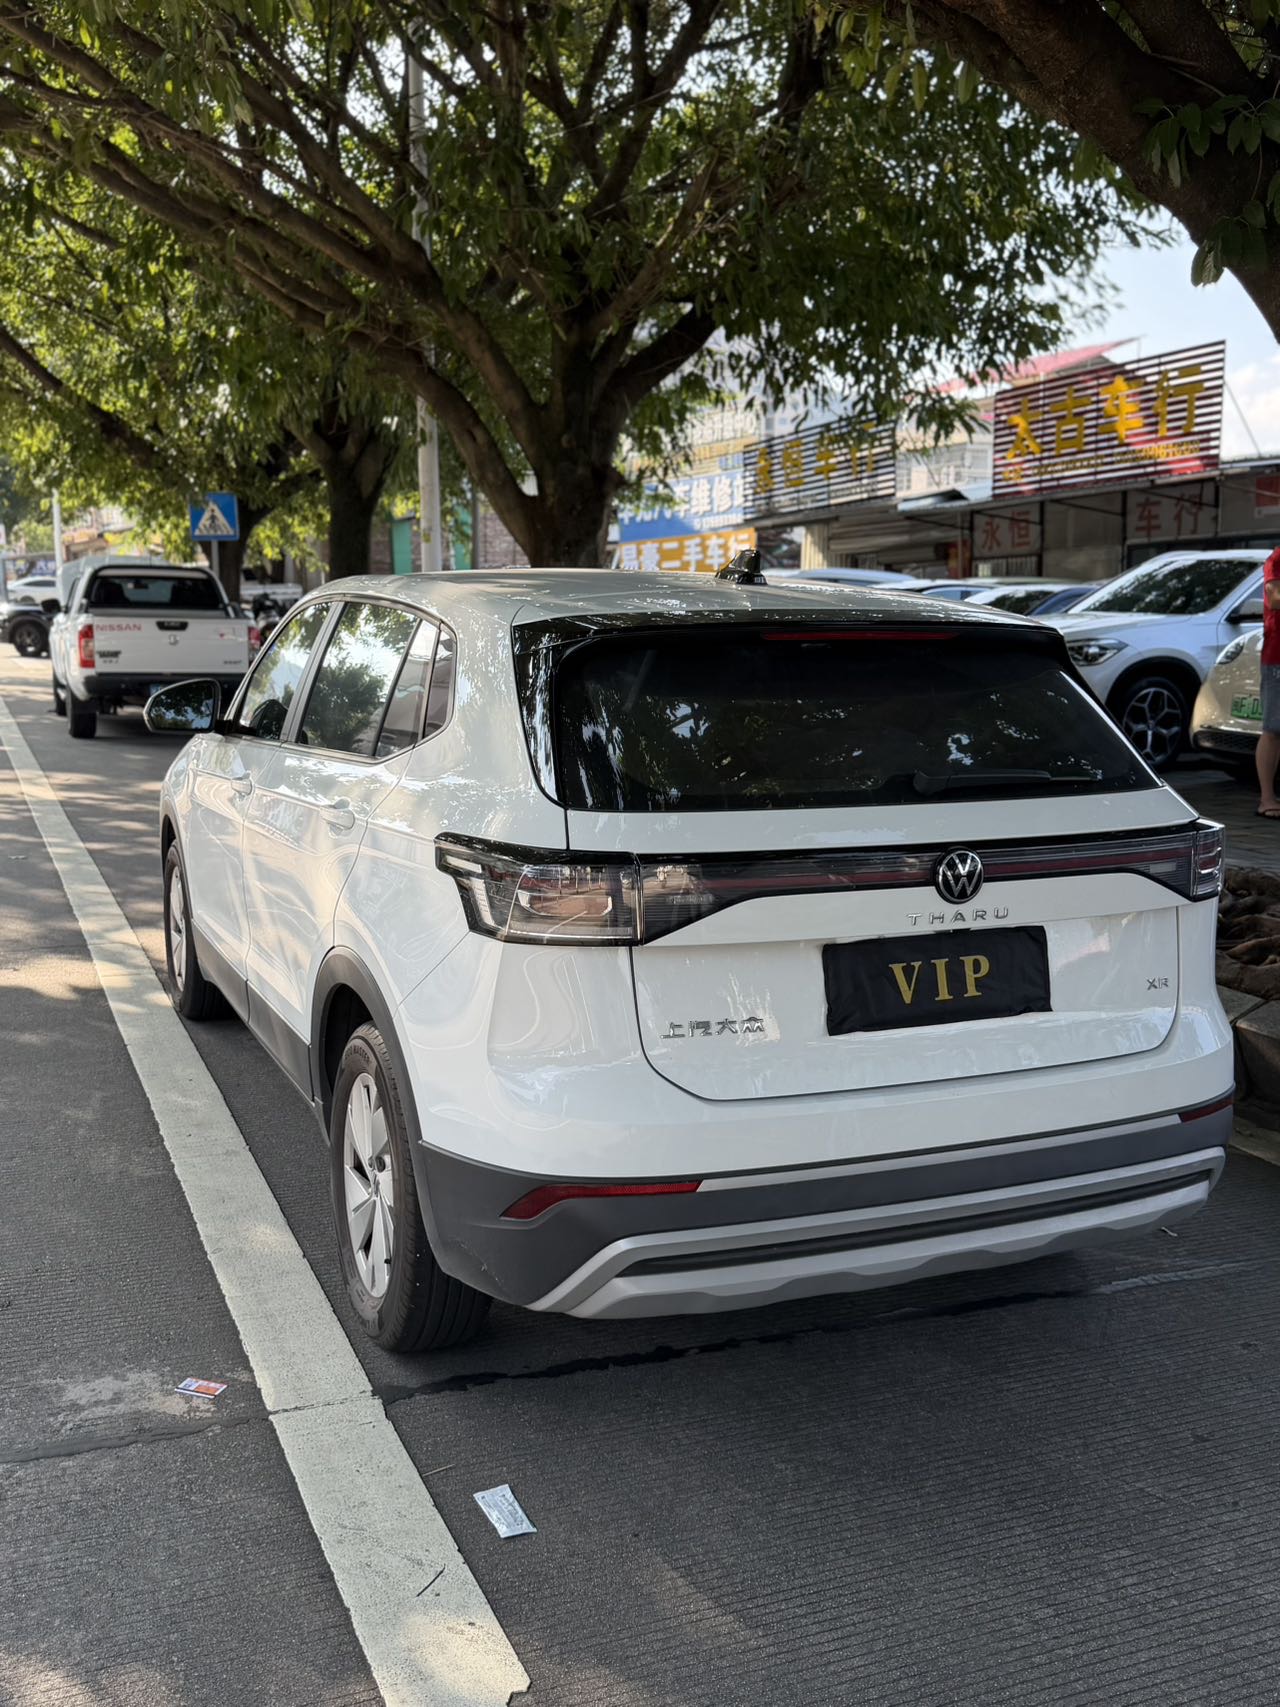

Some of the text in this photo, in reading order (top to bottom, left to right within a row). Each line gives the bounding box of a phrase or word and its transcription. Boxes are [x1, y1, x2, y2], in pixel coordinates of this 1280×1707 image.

[1006, 364, 1206, 460] 太古车行
[982, 510, 1031, 550] 永恒
[1134, 493, 1203, 543] 车行
[95, 623, 143, 632] NISSAN
[906, 906, 1009, 926] THARU
[888, 953, 992, 1005] VIP
